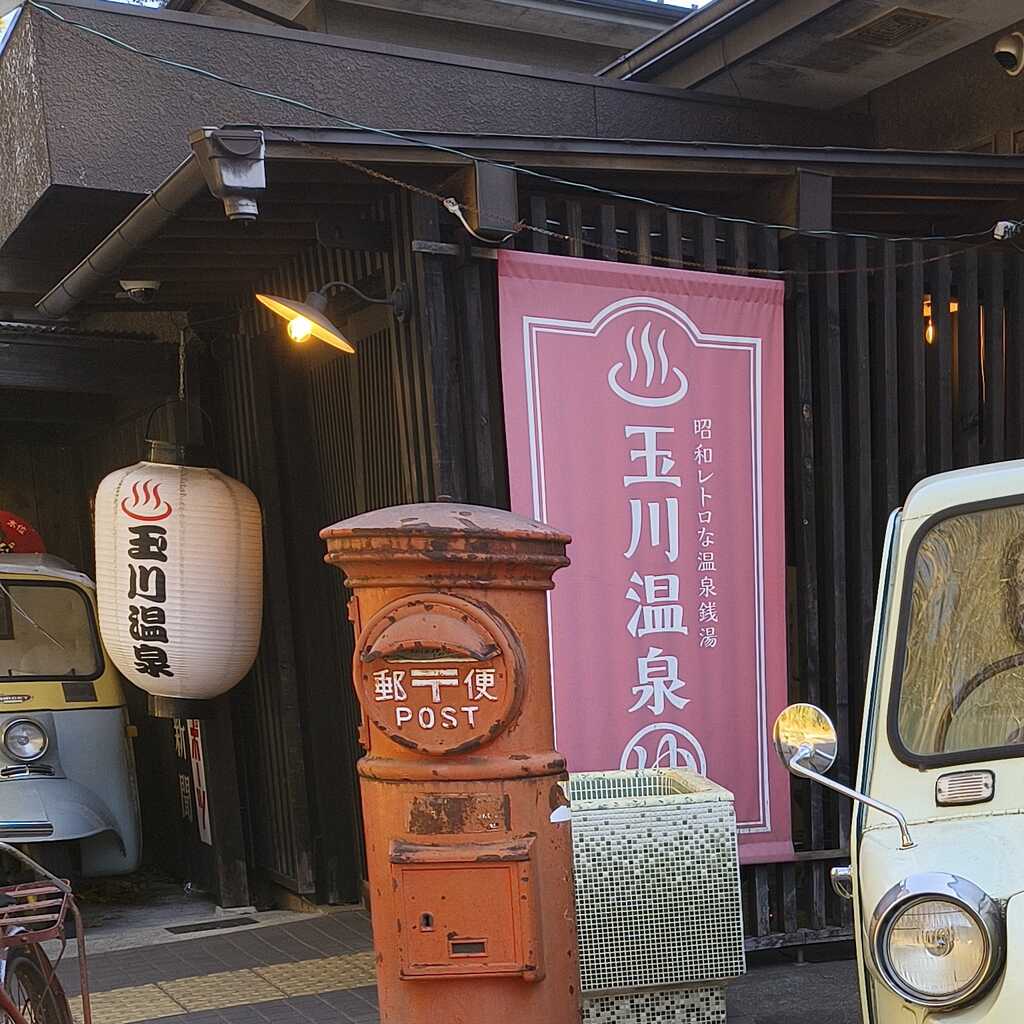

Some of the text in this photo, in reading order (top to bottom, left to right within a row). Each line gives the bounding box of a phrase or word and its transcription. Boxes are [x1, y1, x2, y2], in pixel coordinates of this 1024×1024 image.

[127, 524, 175, 679] 玉川温泉
[623, 425, 692, 715] 玉川温泉
[694, 418, 718, 648] 昭和レトロな温泉銭湯
[395, 706, 480, 730] POST
